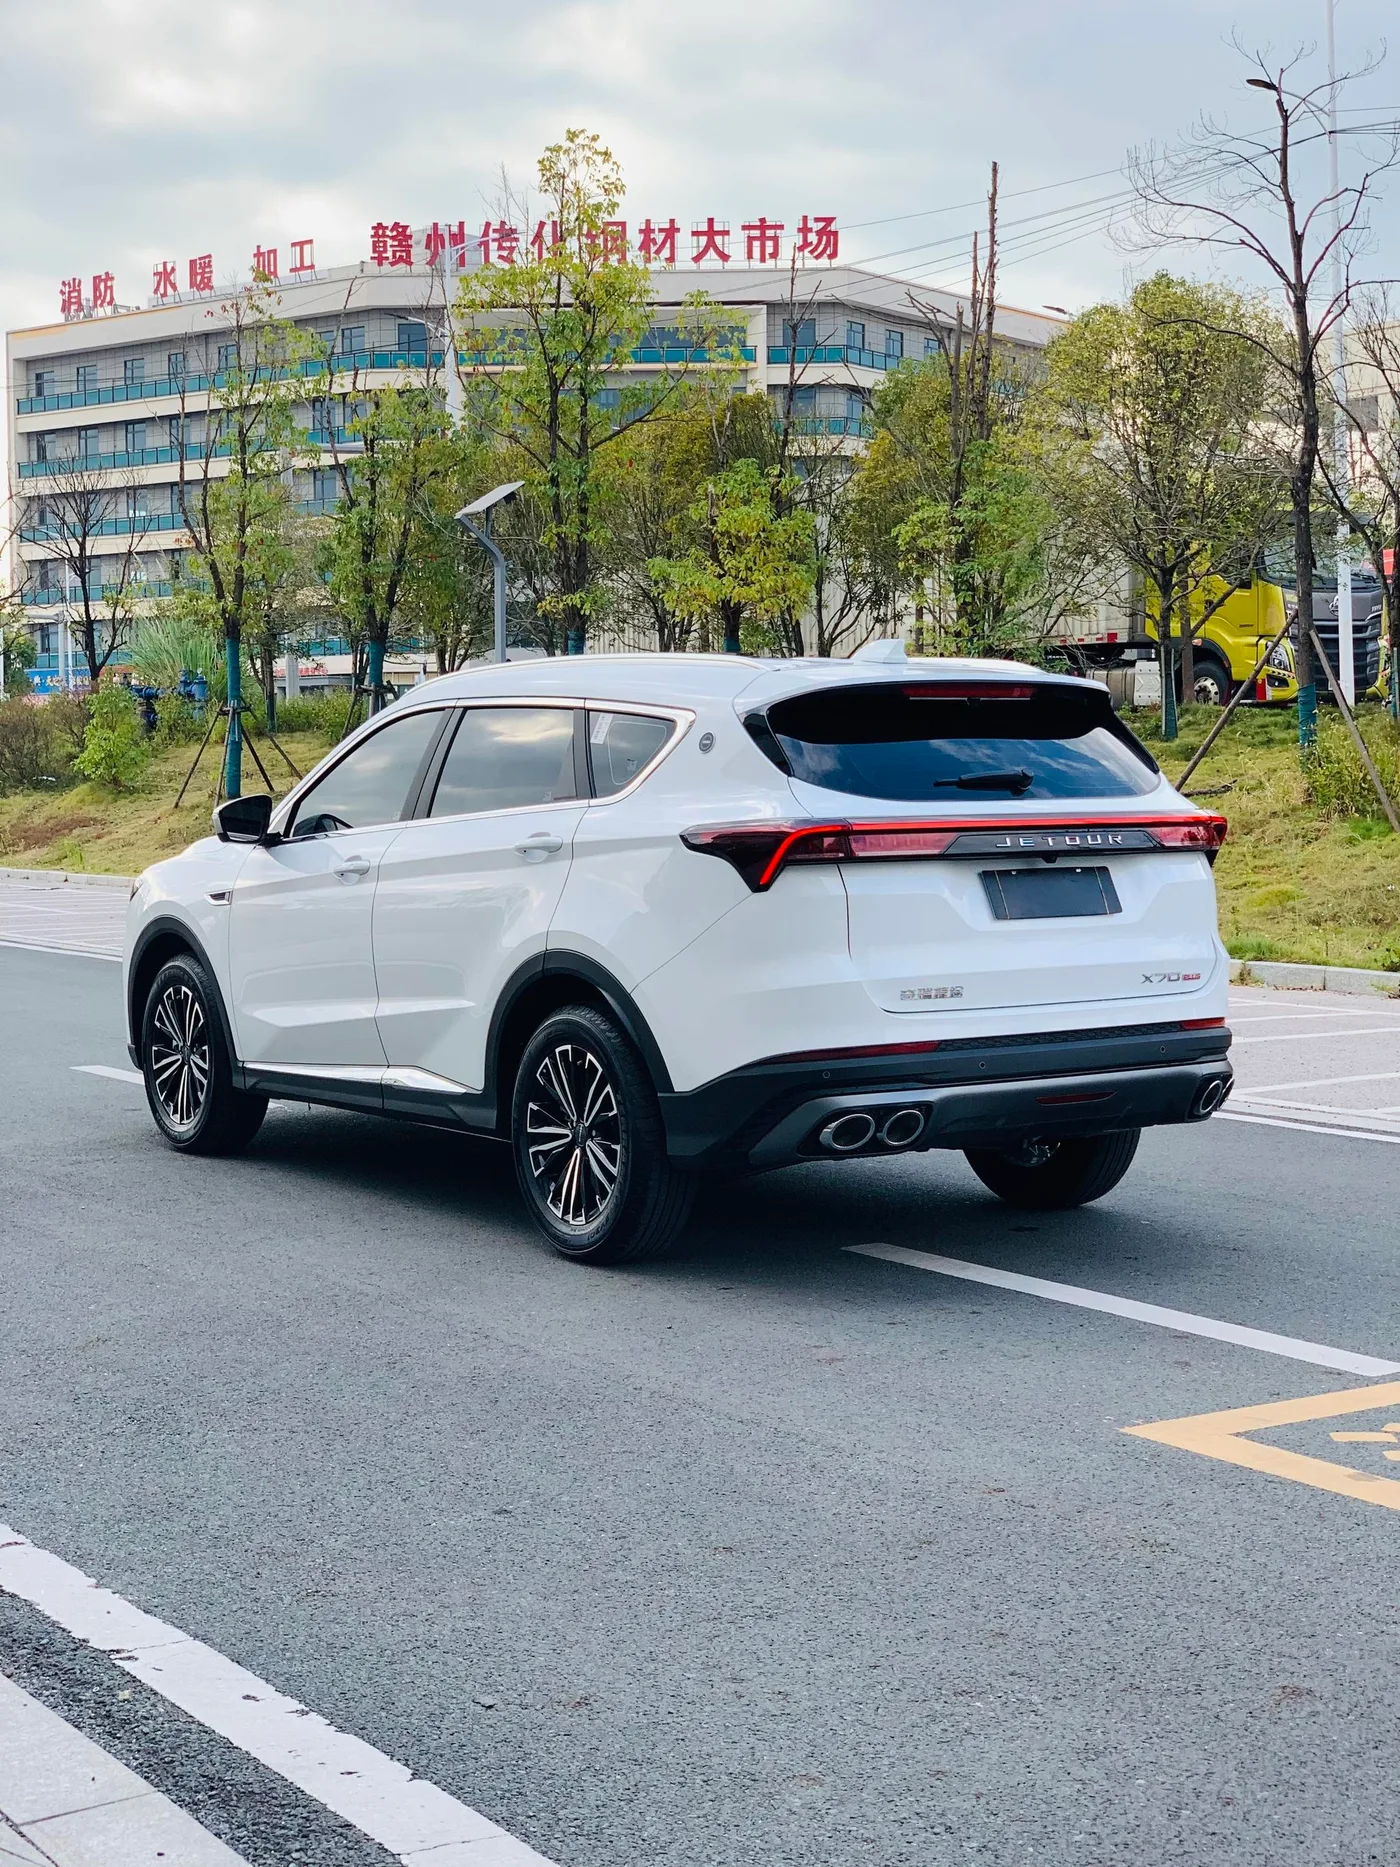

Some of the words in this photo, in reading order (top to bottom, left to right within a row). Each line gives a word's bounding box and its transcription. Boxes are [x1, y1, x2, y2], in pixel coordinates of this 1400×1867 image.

[370, 215, 839, 268] 赣州传化钢材大市场
[59, 271, 115, 315] 消防
[153, 253, 214, 298] 水暖
[252, 239, 315, 283] 加工
[996, 834, 1123, 847] JETOUR
[1141, 972, 1180, 984] X70
